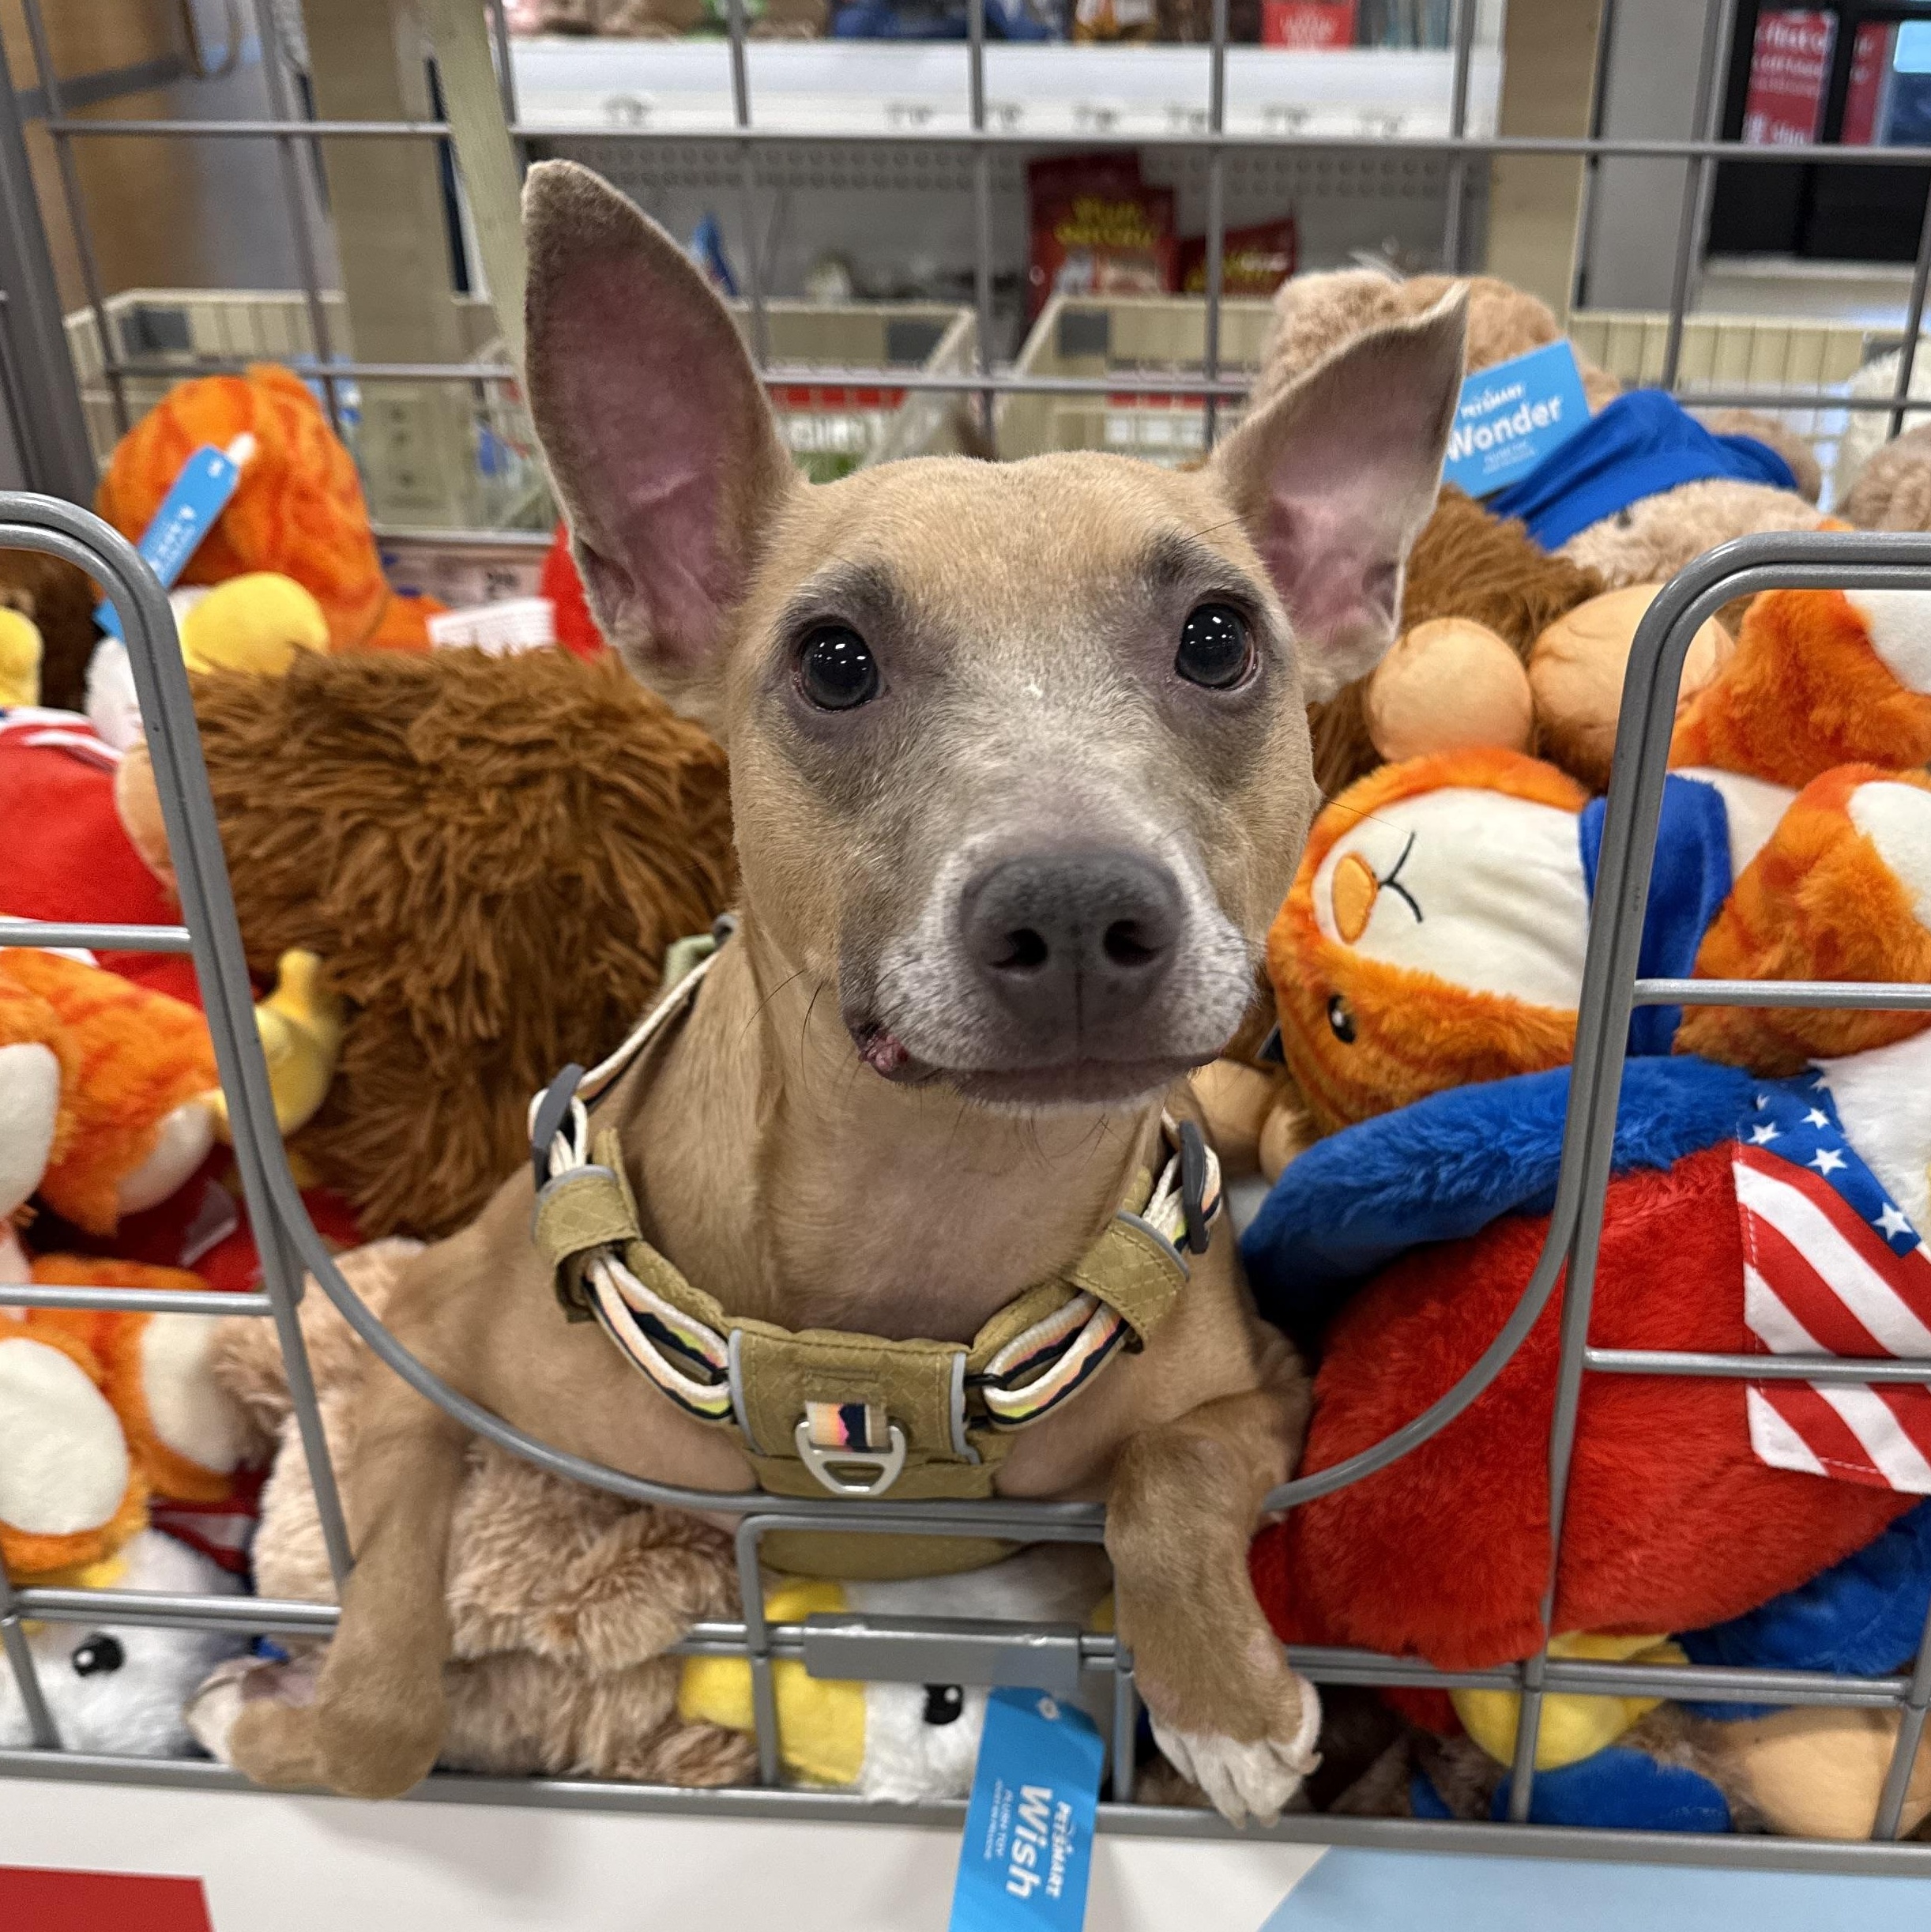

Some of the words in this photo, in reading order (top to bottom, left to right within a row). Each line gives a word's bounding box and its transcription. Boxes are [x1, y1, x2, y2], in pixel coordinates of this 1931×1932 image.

[1447, 395, 1562, 462] Wonder
[1006, 1784, 1052, 1898] Wish
[1045, 1801, 1073, 1898] PETSMART
